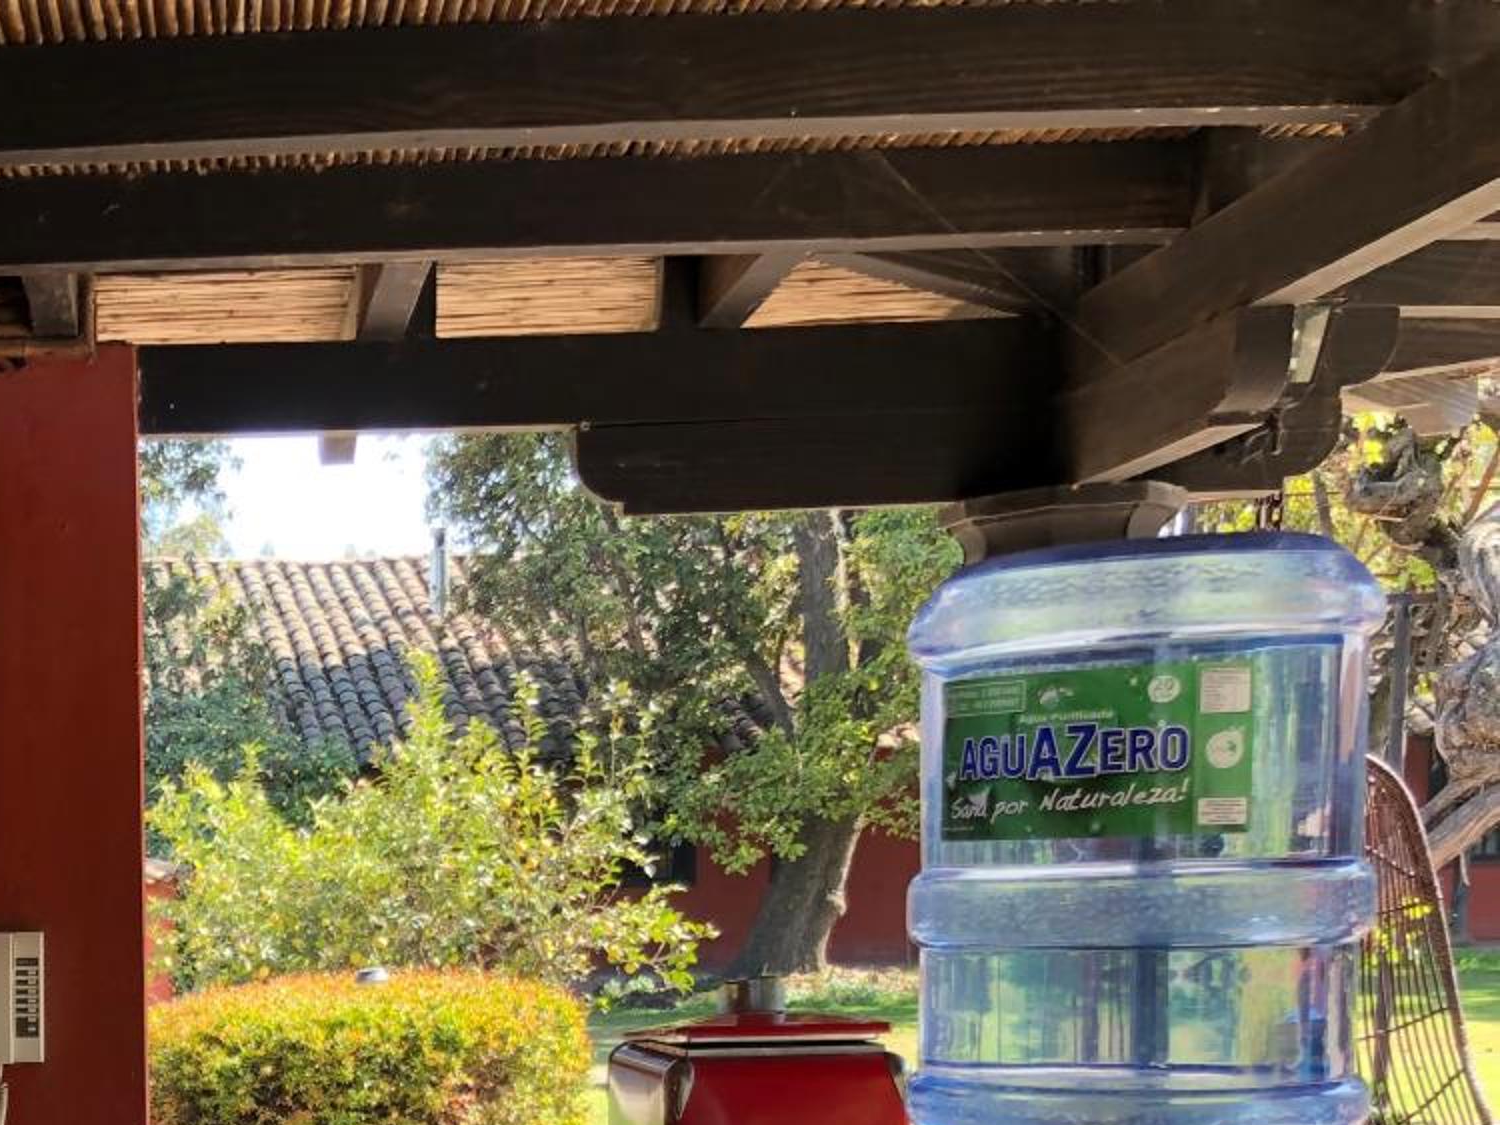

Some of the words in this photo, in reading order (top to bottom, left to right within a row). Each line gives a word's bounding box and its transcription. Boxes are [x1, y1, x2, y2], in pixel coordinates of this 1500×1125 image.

[960, 722, 1191, 782] AGUAZERO
[991, 799, 1029, 824] por
[1038, 778, 1189, 813] Naturaleza!
